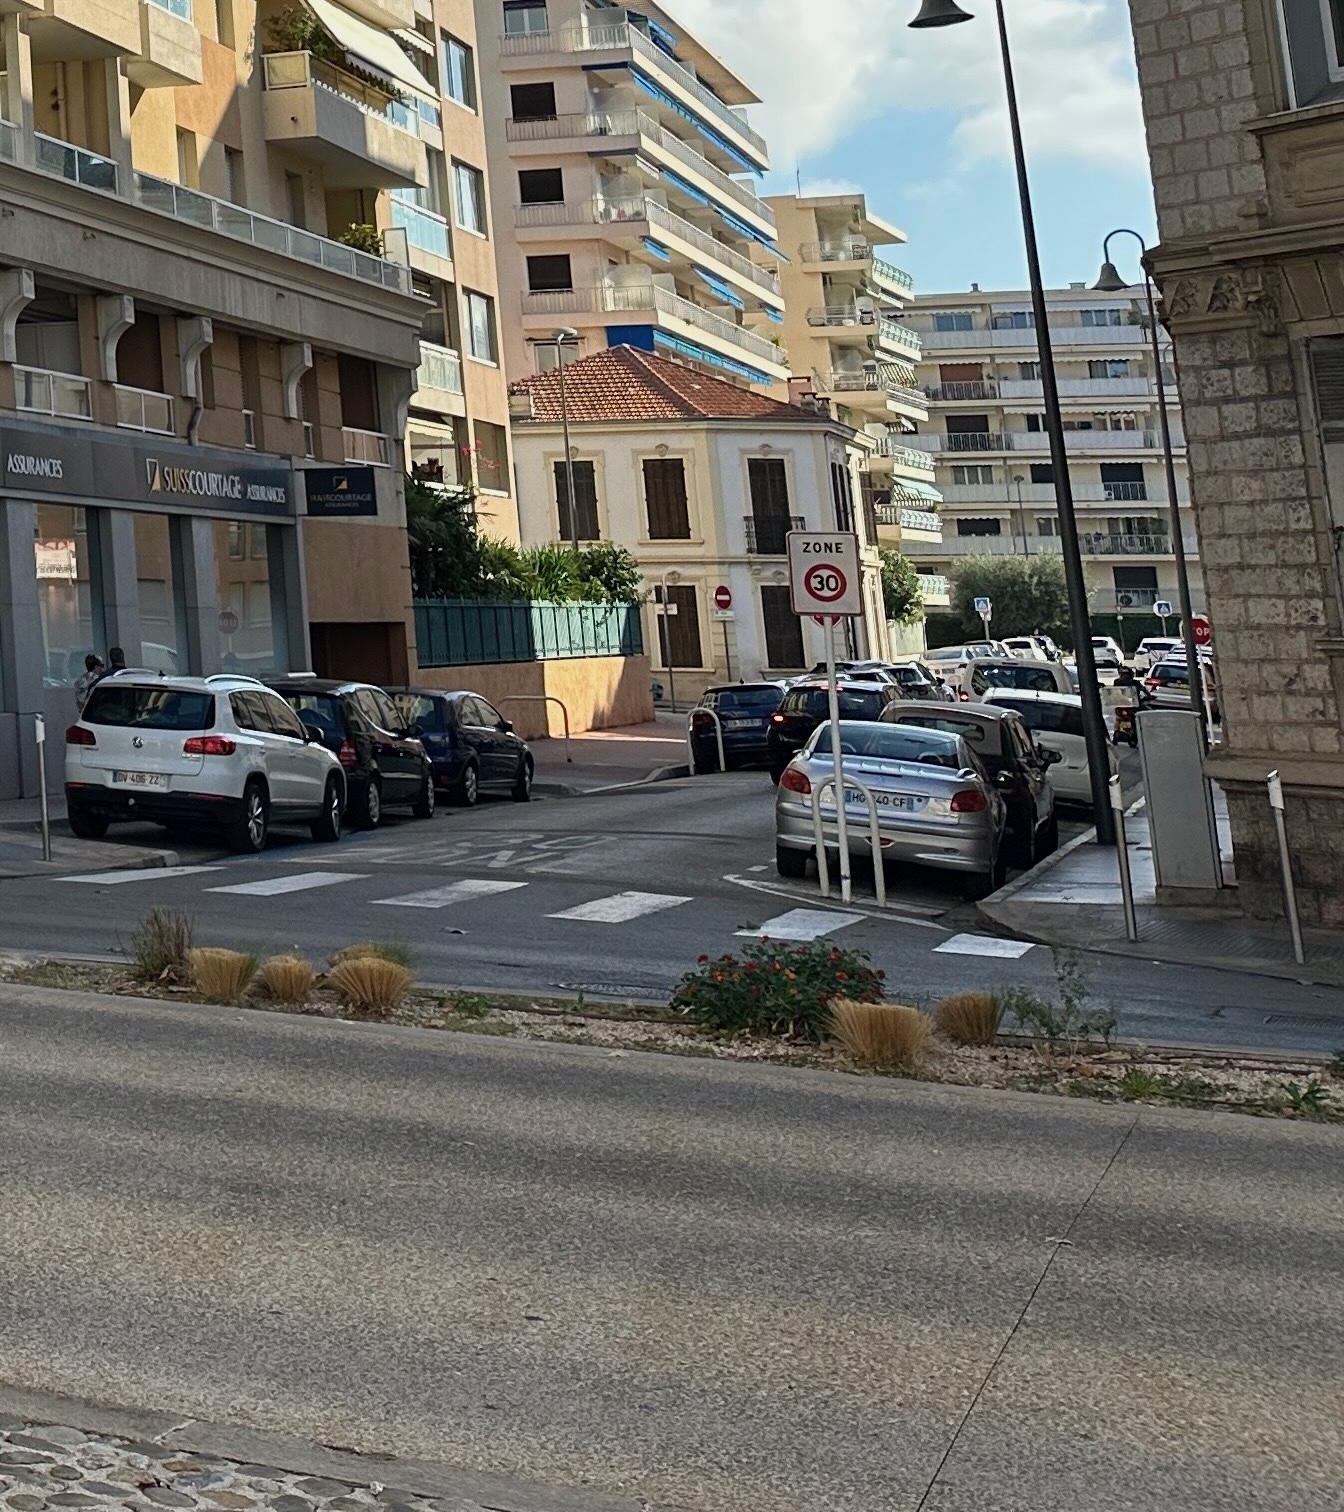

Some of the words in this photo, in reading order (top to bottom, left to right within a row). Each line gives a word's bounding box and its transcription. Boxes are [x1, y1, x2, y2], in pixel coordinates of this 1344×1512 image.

[7, 453, 63, 479] ASSURANCES
[163, 465, 243, 500] SUISSCOURTAGE
[802, 542, 844, 554] ZONE
[812, 574, 839, 592] 30
